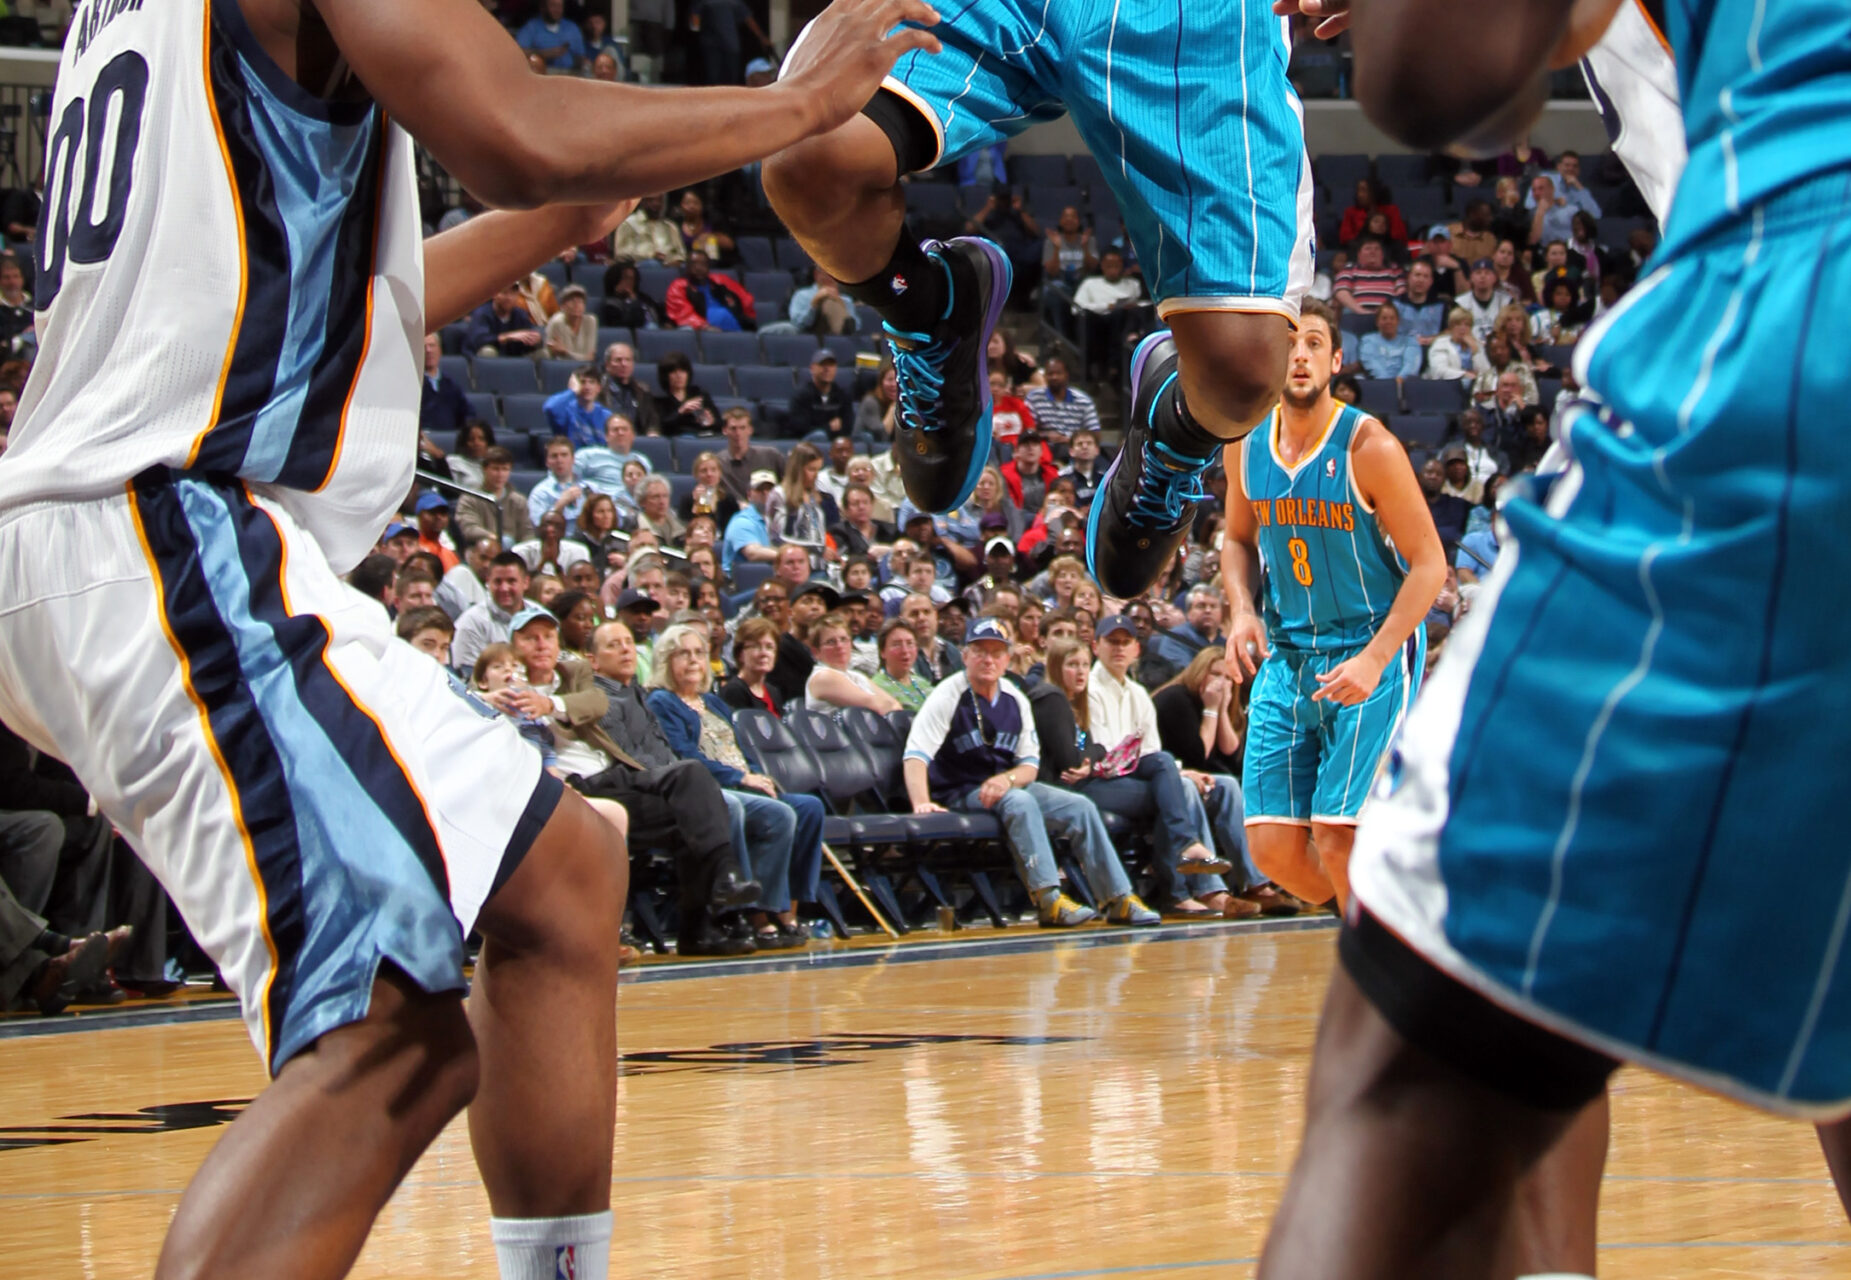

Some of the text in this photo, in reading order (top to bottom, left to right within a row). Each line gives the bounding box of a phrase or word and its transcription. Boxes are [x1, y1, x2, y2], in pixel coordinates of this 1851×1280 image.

[34, 49, 150, 312] 00
[1274, 497, 1355, 532] ORLEANS
[1288, 537, 1314, 587] 8
